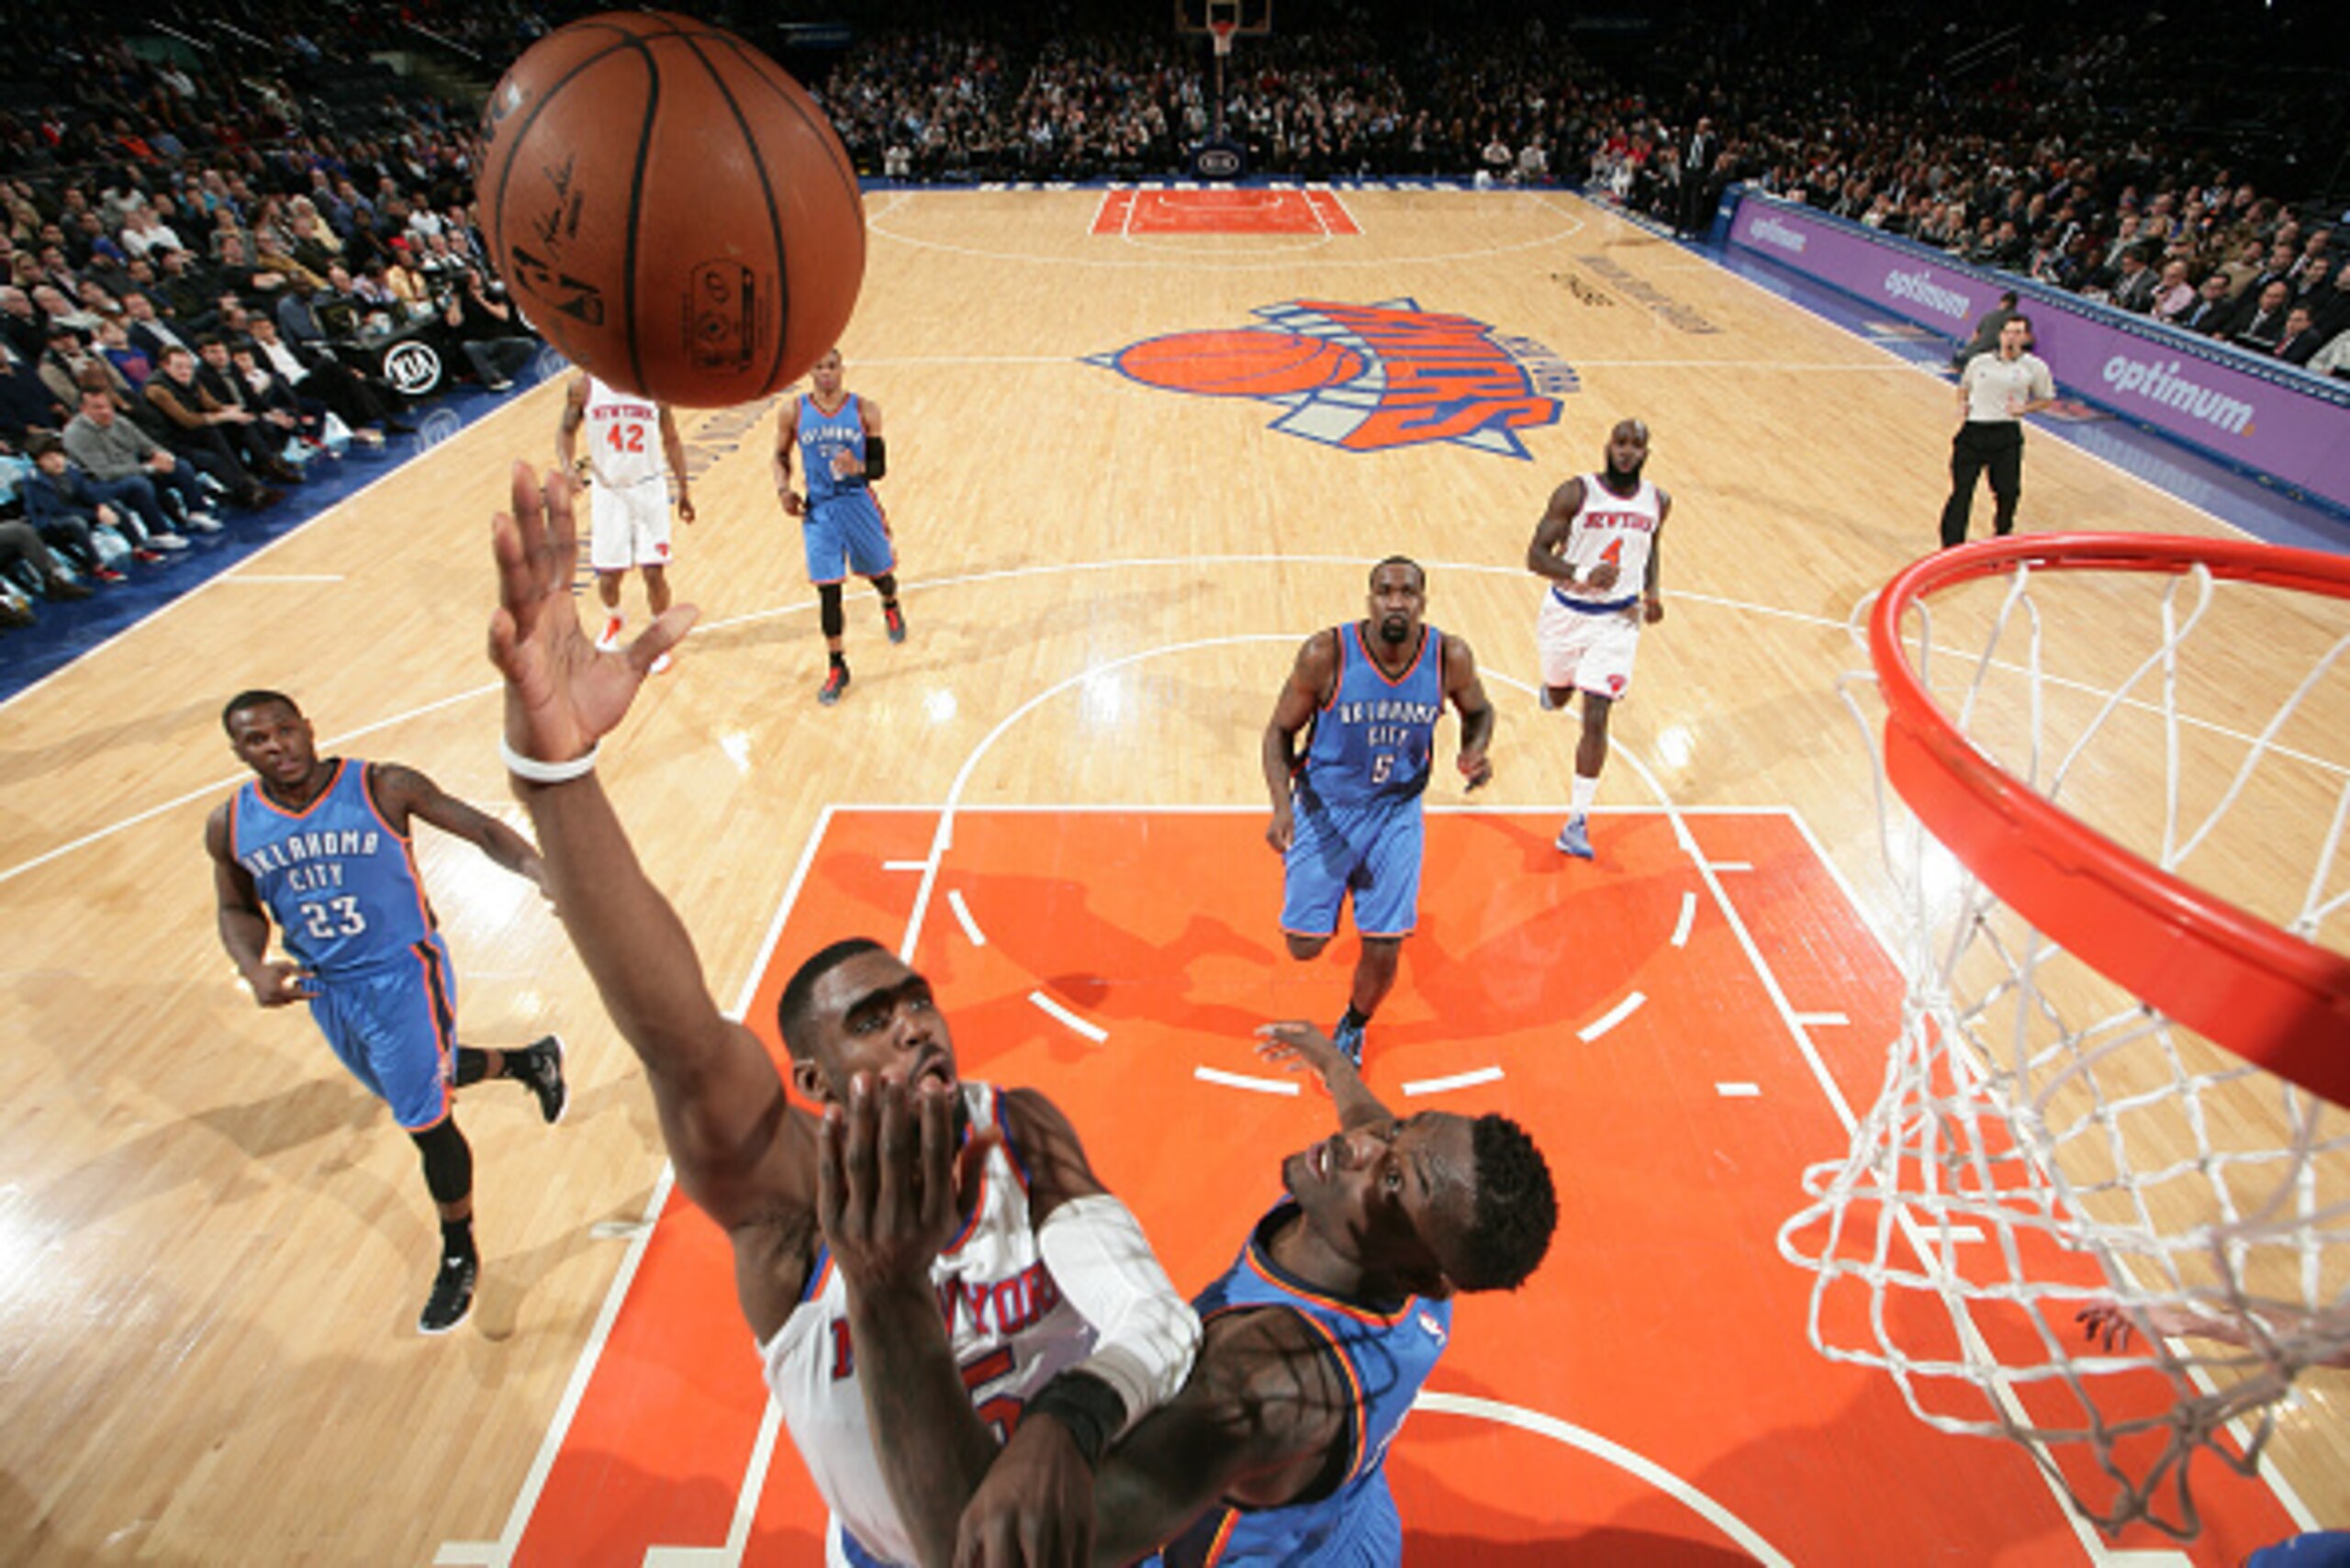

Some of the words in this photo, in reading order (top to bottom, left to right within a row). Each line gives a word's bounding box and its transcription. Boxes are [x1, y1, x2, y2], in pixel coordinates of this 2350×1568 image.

[606, 423, 644, 453] 42
[1599, 536, 1624, 567] 4
[287, 863, 343, 891] CITY
[300, 895, 367, 939] 23
